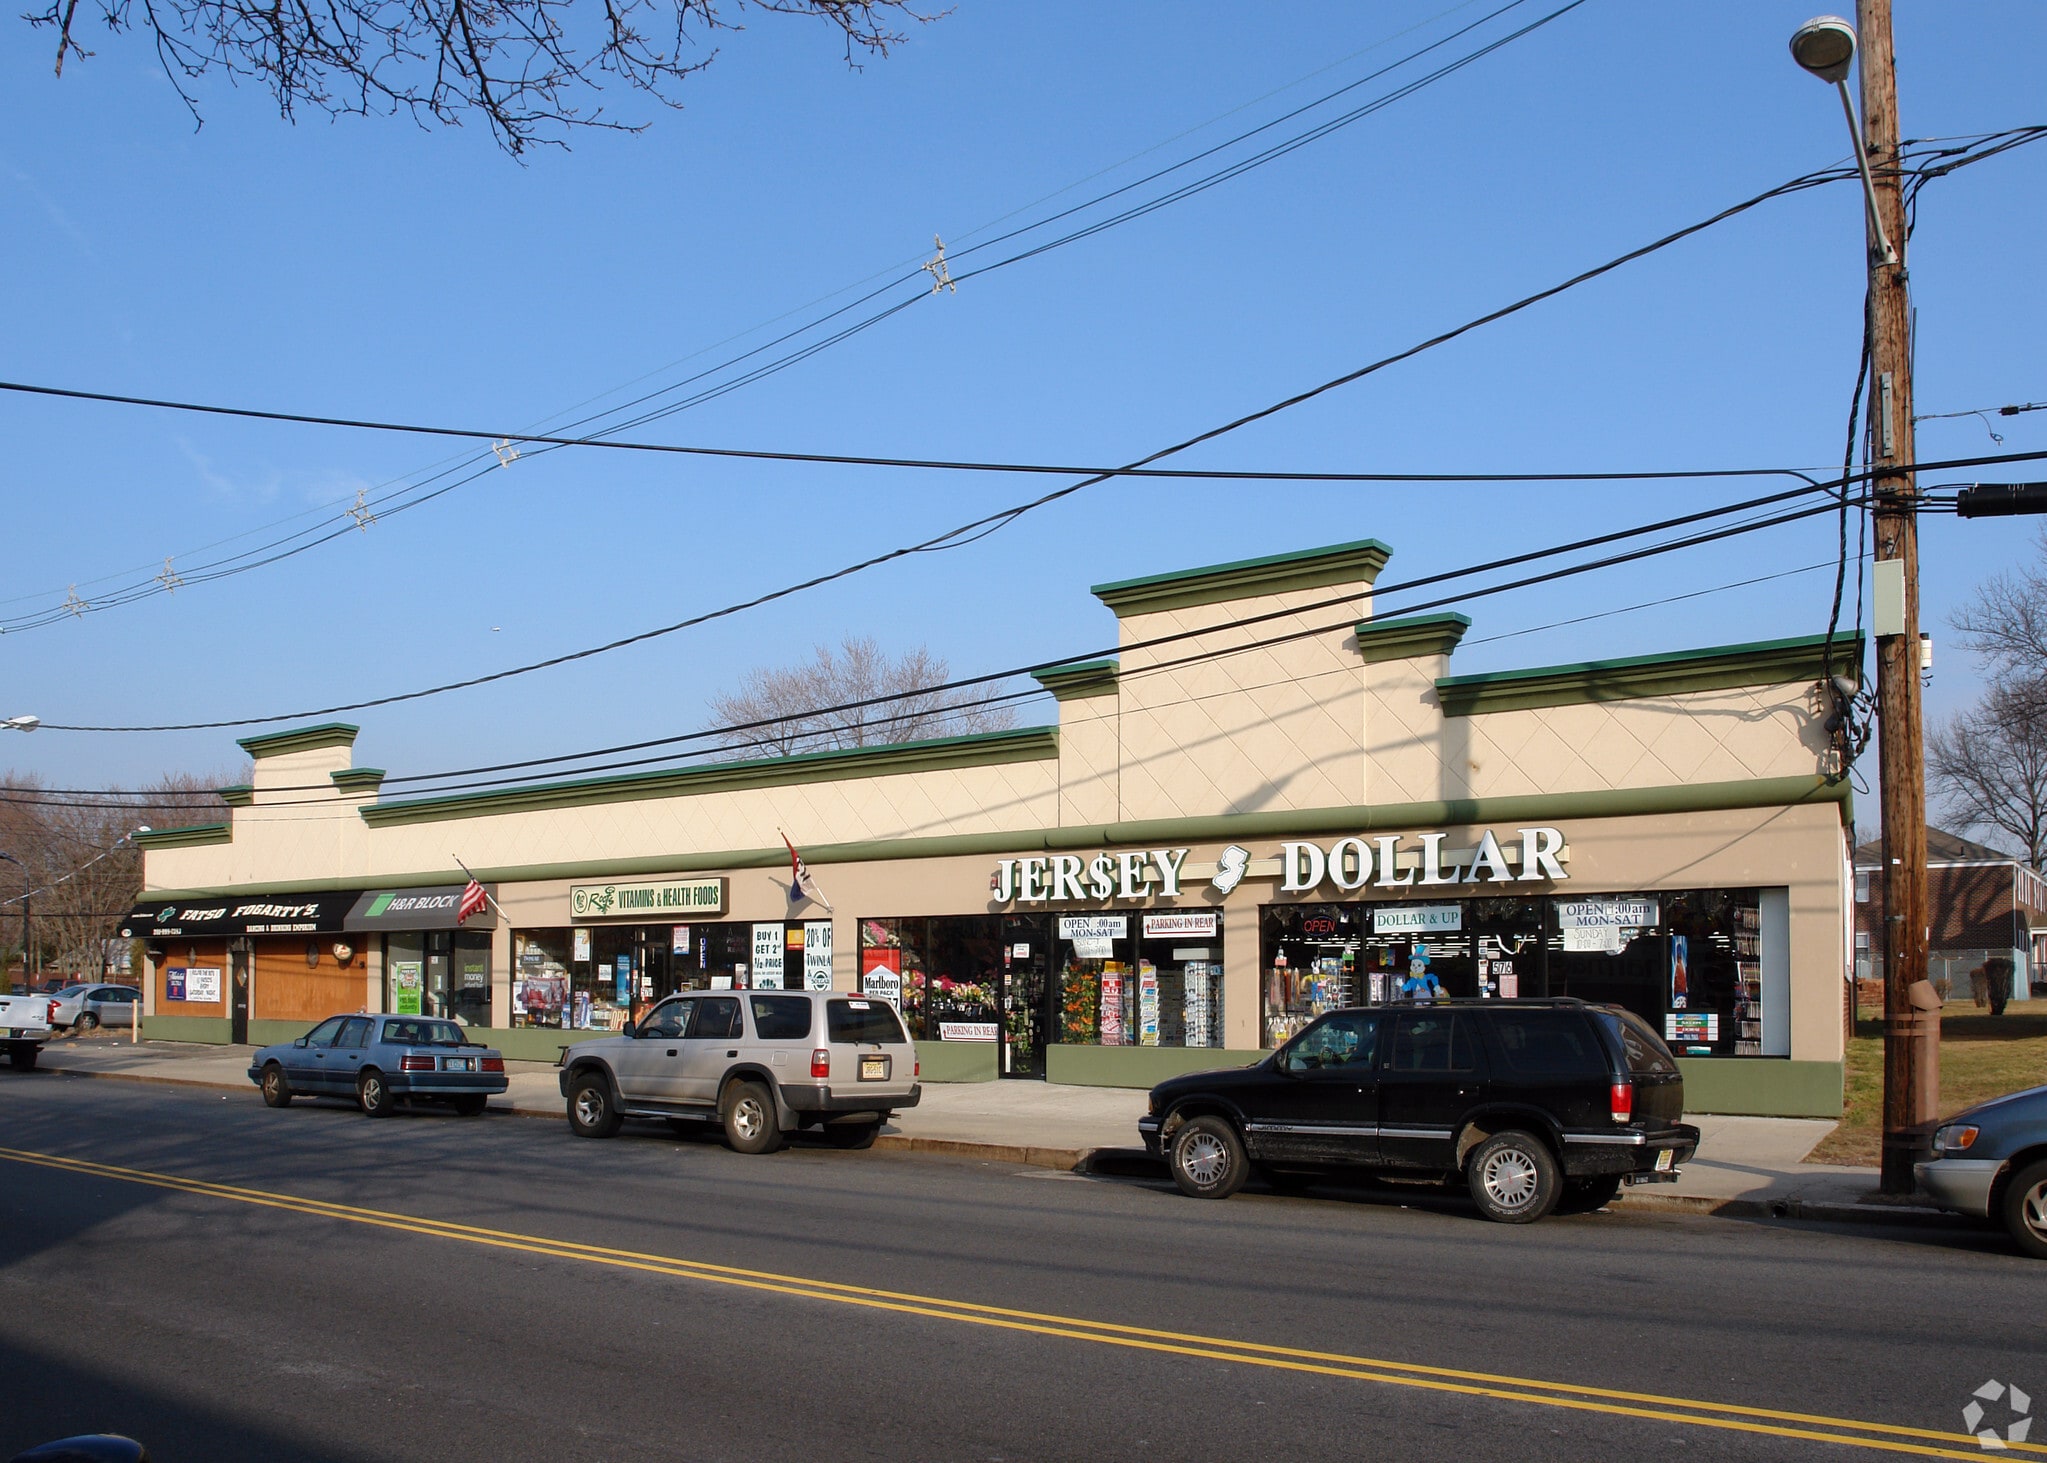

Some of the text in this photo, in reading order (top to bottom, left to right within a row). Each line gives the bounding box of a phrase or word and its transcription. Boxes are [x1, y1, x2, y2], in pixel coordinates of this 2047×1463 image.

[1280, 826, 1569, 892] DOLLAR
[387, 894, 460, 911] H&R BLOCK
[588, 885, 719, 914] Roots VITAMINS & HEALTH FOODS
[178, 903, 319, 921] FATSO FOGARTY'S
[1566, 903, 1650, 916] OPEN :00am
[1064, 918, 1121, 929] OPEN :00am
[1151, 917, 1214, 930] PARKING IN REAR
[1377, 911, 1459, 927] DOLLAR & UP
[1576, 914, 1641, 926] MON-SAT
[1303, 920, 1336, 932] OPEN
[756, 931, 779, 941] BUY 1
[806, 927, 832, 948] 20% OF
[1070, 928, 1115, 938] MON-SAT
[1573, 928, 1609, 940] SUNDAY
[699, 937, 707, 969] OPEN
[755, 944, 770, 955] GET
[464, 963, 484, 973] instant
[765, 957, 782, 968] PRICE
[1493, 961, 1513, 974] 576
[464, 973, 484, 983] money
[864, 975, 899, 989] Marlboro
[946, 1025, 973, 1035] PARKING
[974, 1025, 982, 1035] IN
